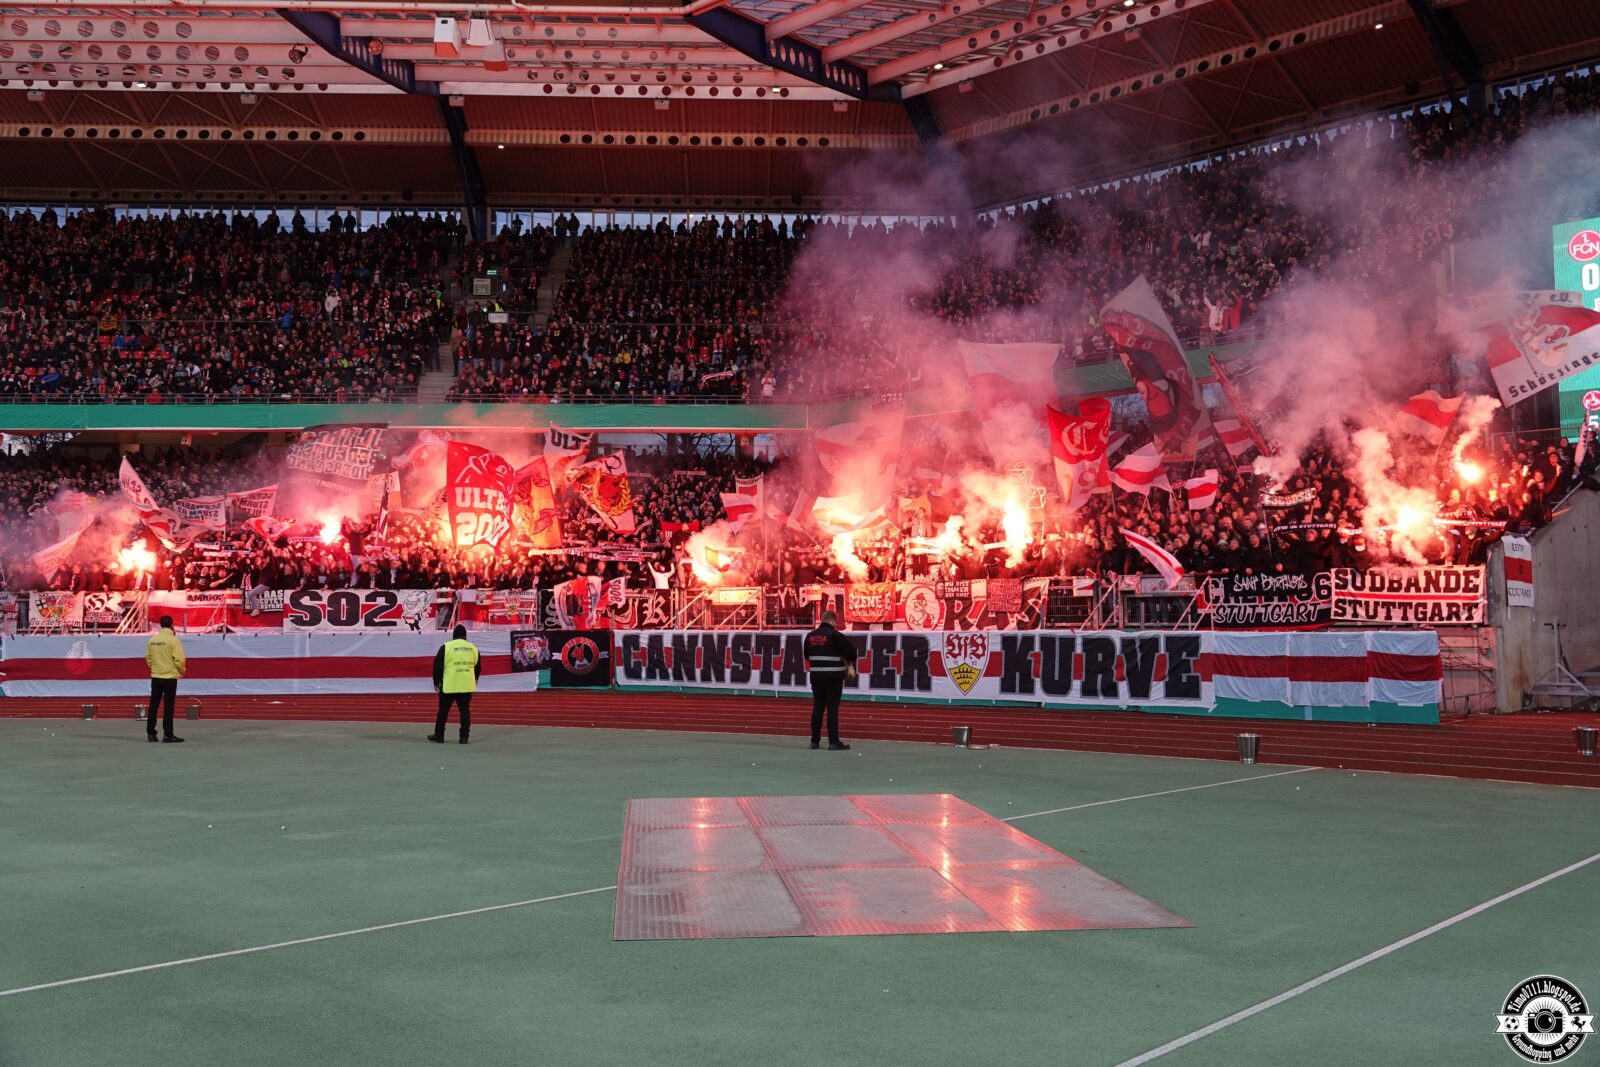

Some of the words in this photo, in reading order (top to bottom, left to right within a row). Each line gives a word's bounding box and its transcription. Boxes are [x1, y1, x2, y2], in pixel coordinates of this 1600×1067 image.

[1573, 241, 1600, 256] FCN
[1213, 601, 1321, 624] STUTTGART
[1333, 598, 1479, 622] STUTTGART
[1000, 633, 1204, 700] KURVE
